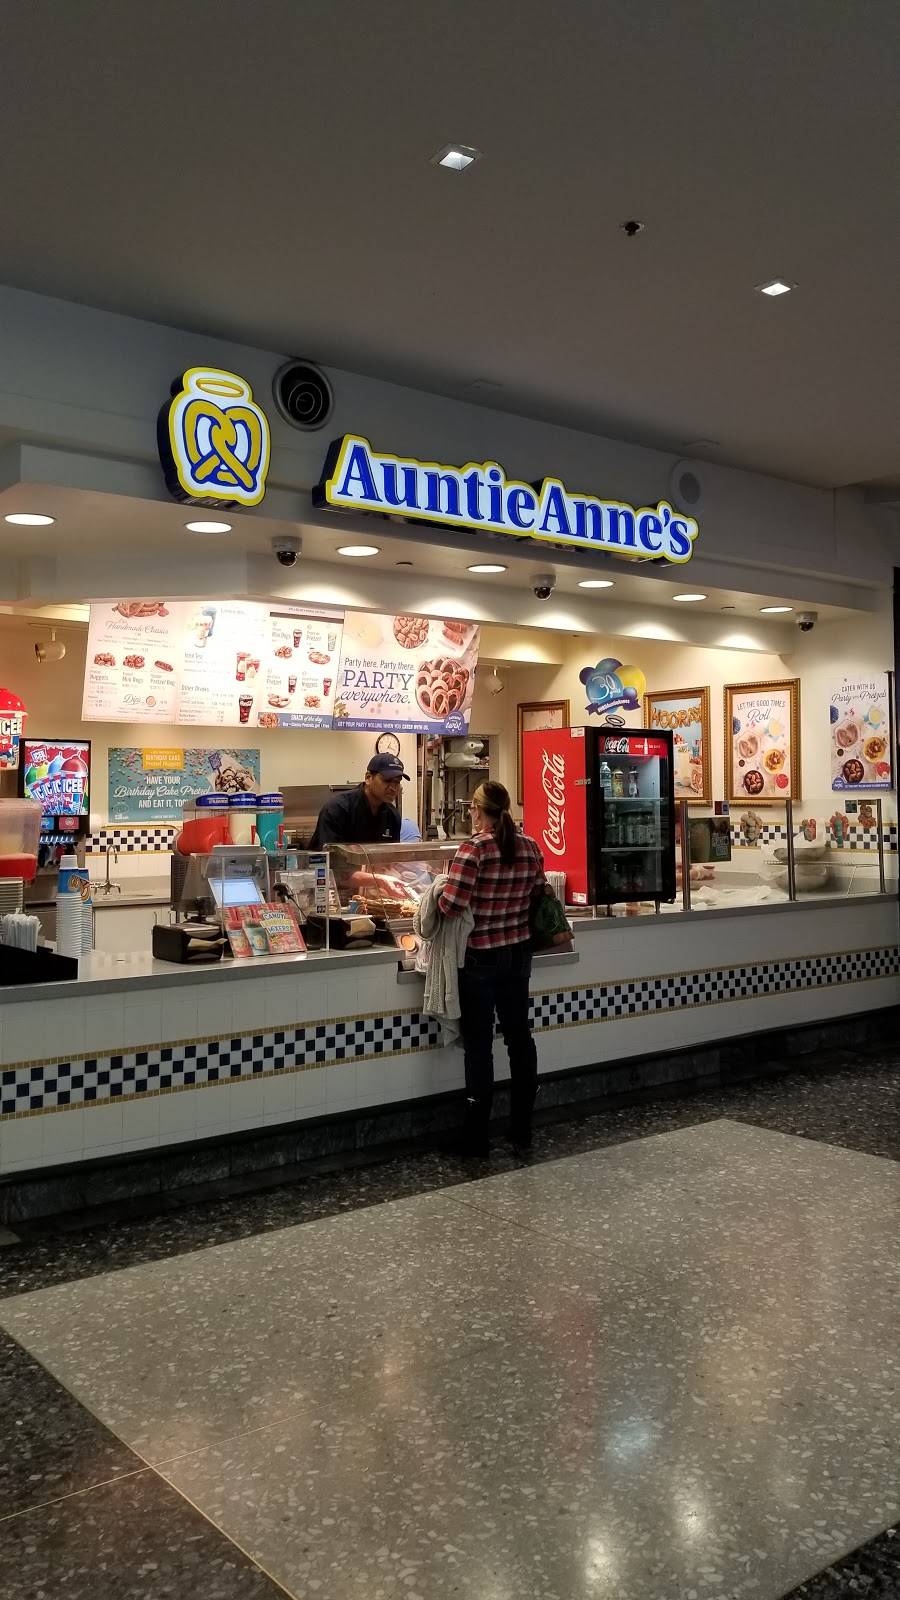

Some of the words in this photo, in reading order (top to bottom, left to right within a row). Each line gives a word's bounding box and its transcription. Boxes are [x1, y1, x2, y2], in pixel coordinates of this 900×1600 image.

[337, 444, 536, 528] Auntie
[538, 485, 691, 556] Anne's
[344, 657, 361, 668] Party
[362, 659, 378, 668] here.
[380, 660, 397, 670] Party
[398, 661, 414, 671] there.
[342, 670, 414, 691] PARTY
[591, 675, 616, 700] 30
[341, 688, 411, 708] everywhere.
[831, 693, 852, 704] Party
[747, 708, 771, 723] Roll
[62, 778, 83, 793] ICEE
[146, 775, 163, 785] HAVE
[164, 775, 181, 785] YOUR
[113, 785, 156, 799] Birthday
[156, 785, 178, 797] Cake
[138, 799, 152, 809] AND
[153, 799, 164, 808] EAT
[542, 748, 566, 856] Coca-Cola
